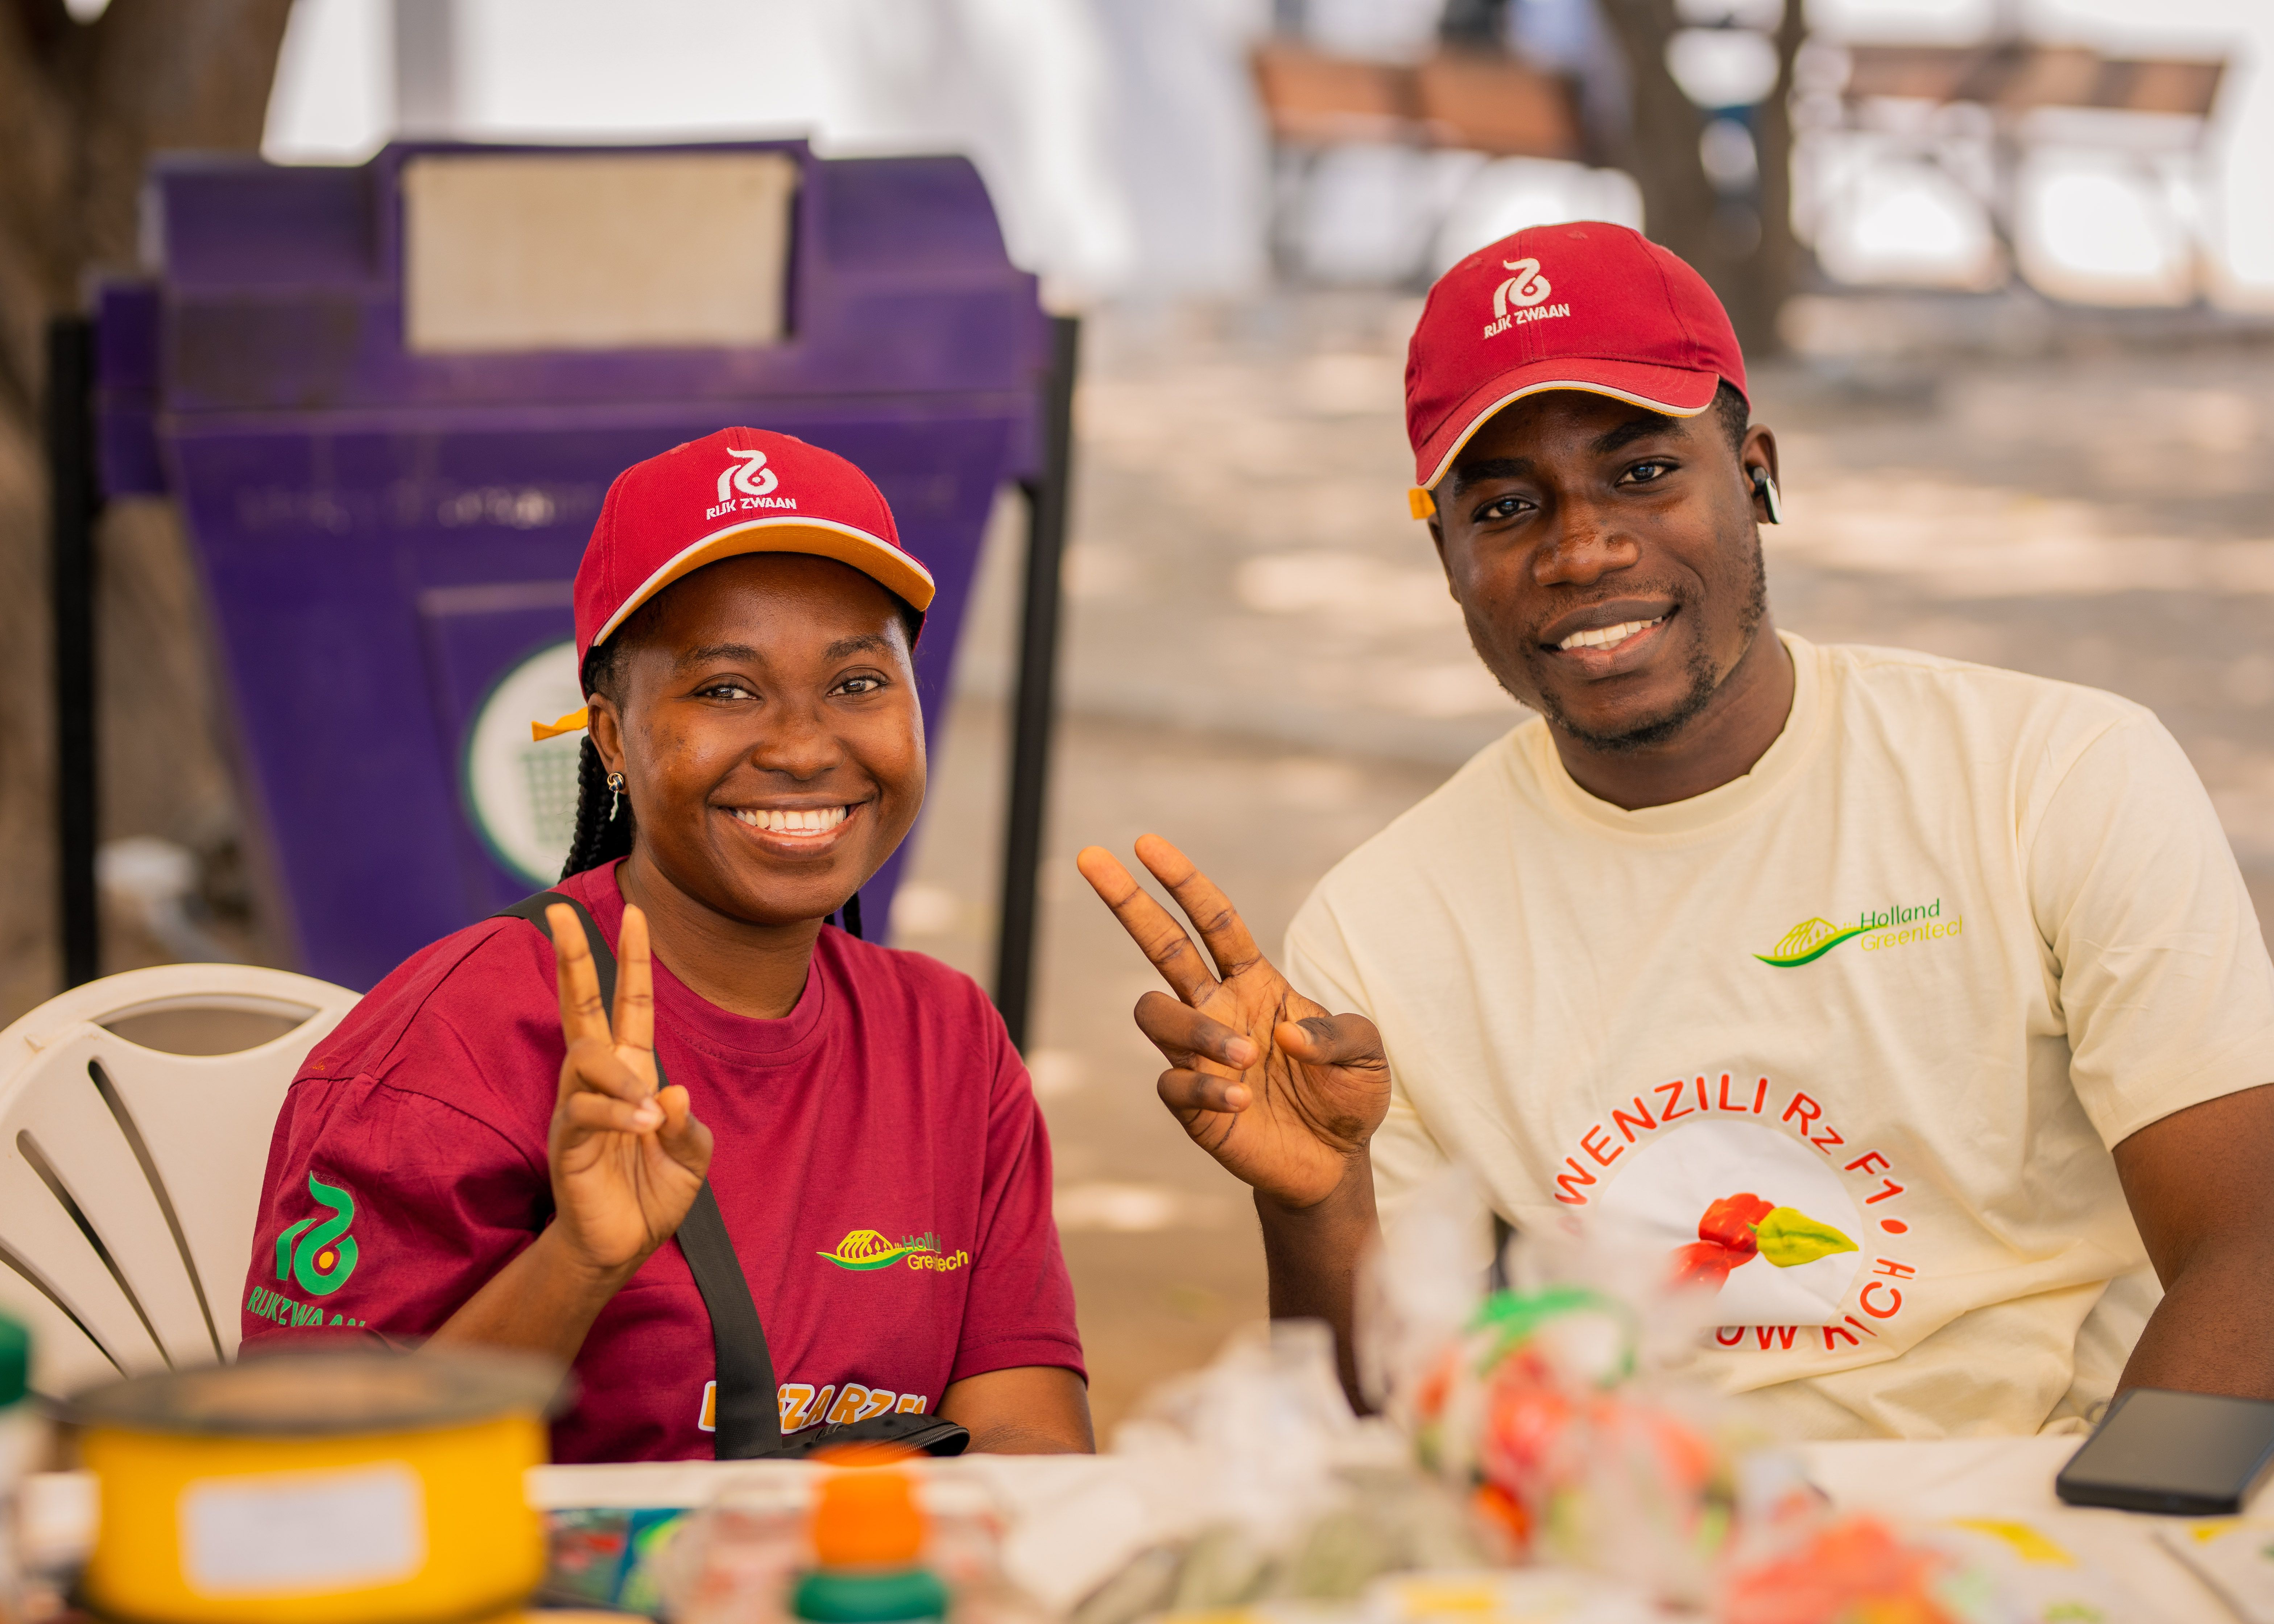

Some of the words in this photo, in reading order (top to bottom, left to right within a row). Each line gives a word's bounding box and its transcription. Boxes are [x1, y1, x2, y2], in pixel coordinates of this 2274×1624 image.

[1484, 314, 1513, 339] RIJK
[1514, 303, 1570, 324] ZWAAN
[706, 499, 736, 520] RIJK
[740, 497, 797, 509] ZWAAN
[1860, 897, 1940, 929] Holland
[1844, 1151, 1904, 1204] F1
[246, 1286, 284, 1321] RIJK
